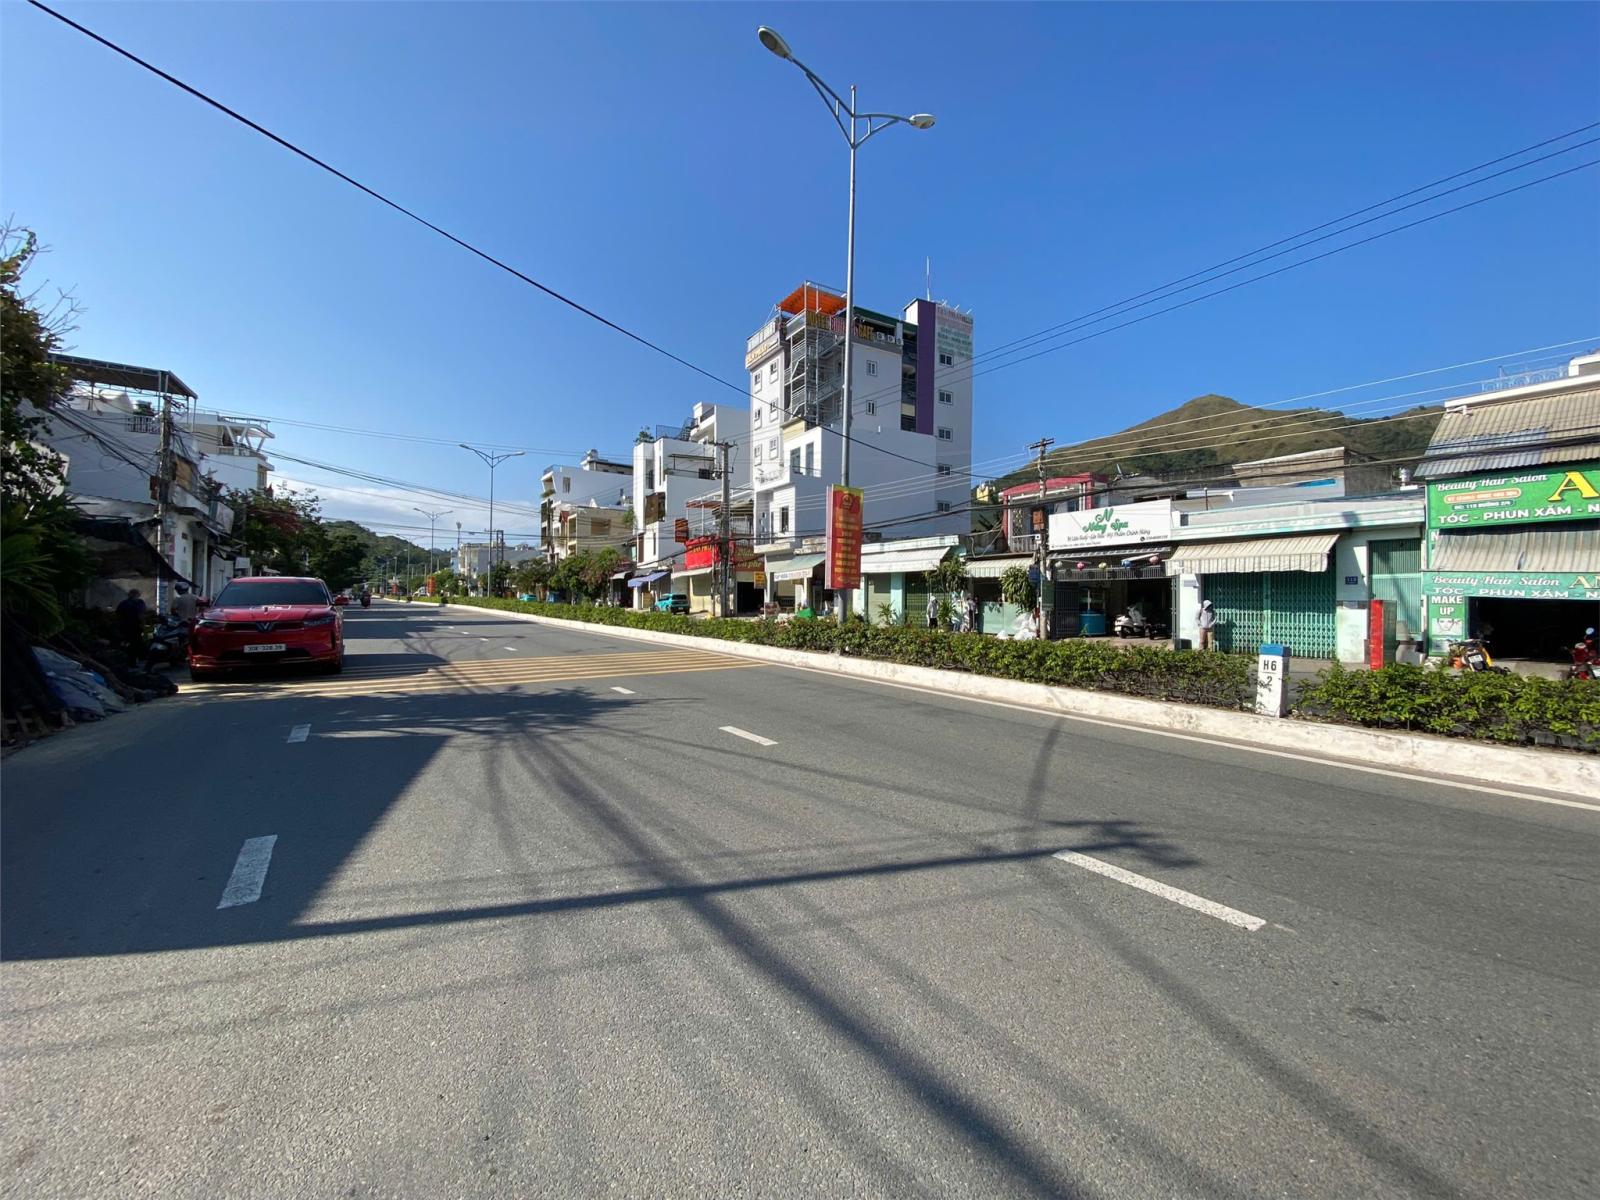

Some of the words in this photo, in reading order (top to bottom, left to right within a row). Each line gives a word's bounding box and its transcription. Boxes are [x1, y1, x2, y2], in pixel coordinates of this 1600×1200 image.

[1436, 481, 1478, 491] Beauty
[1480, 478, 1506, 487] Hair
[1511, 475, 1549, 483] Salon
[1439, 512, 1469, 524] TÓC
[1483, 508, 1529, 520] PHUN
[1534, 505, 1571, 517] XĂM
[1433, 576, 1478, 587] Beauty
[1483, 576, 1512, 584] Hair
[1519, 576, 1559, 586] Salon
[1433, 586, 1463, 594] TÓC
[1479, 588, 1525, 596] PHUN
[1531, 588, 1568, 598] XĂM
[1431, 595, 1463, 604] MAKE
[1439, 607, 1454, 615] UP
[1266, 675, 1273, 686] 2
